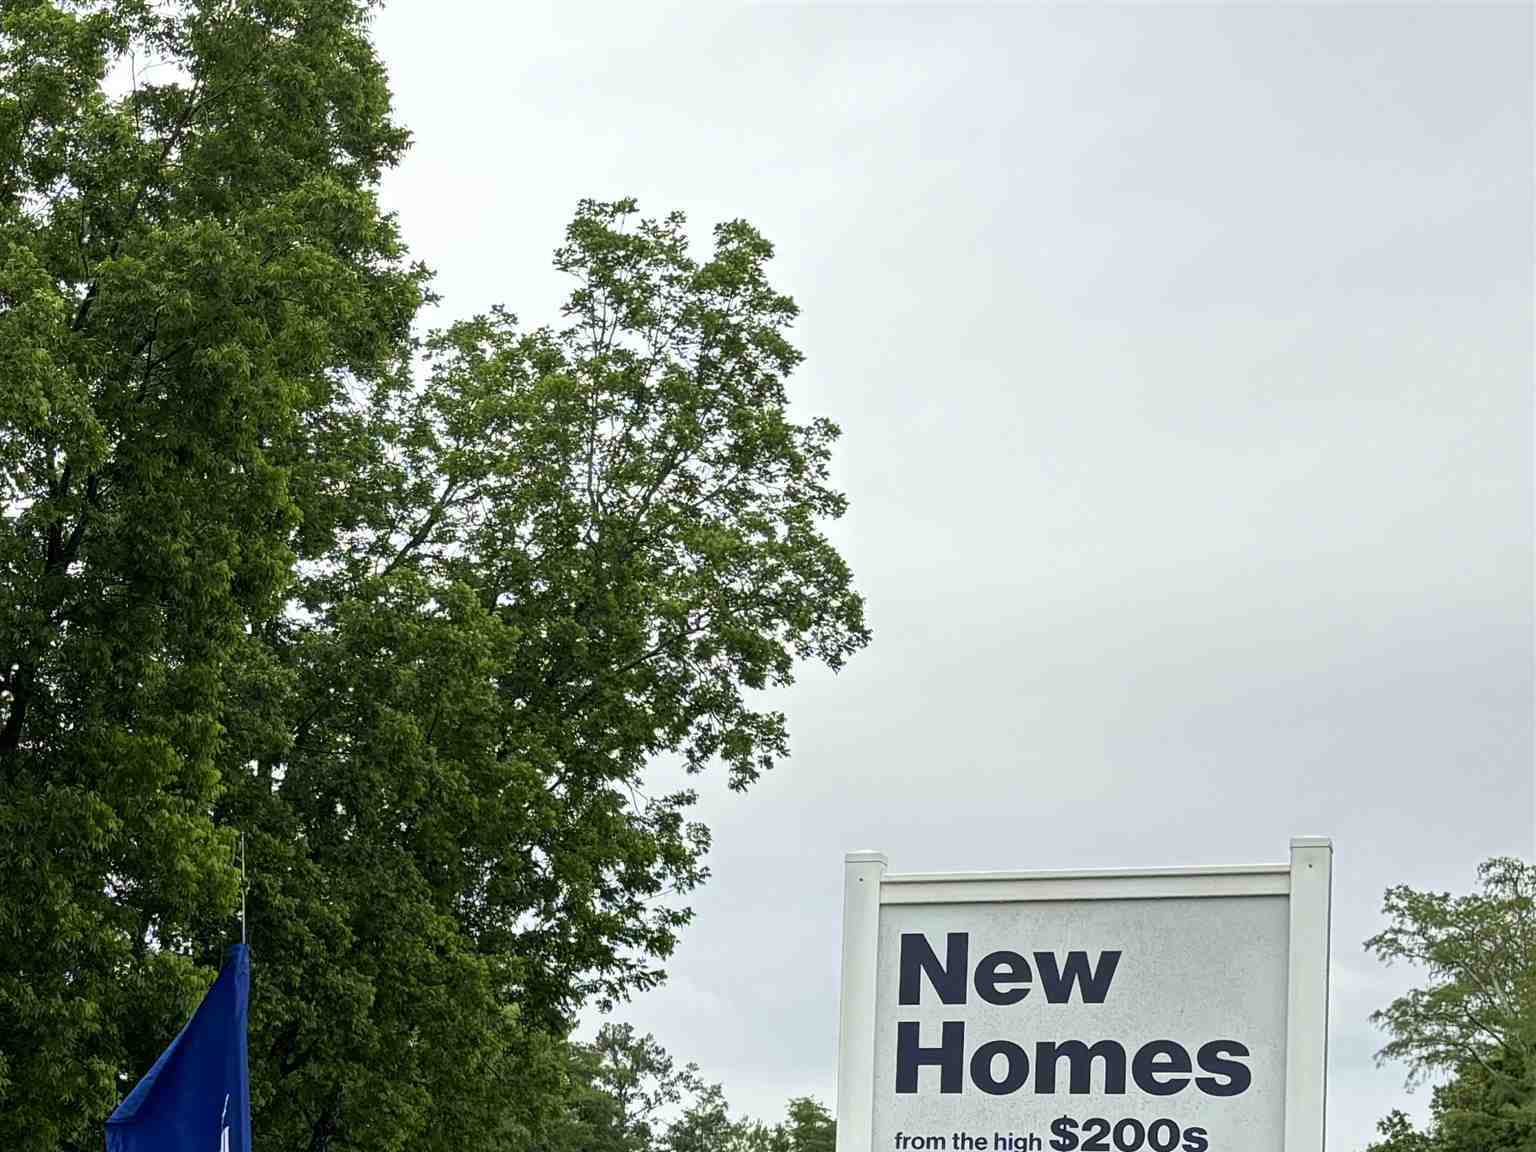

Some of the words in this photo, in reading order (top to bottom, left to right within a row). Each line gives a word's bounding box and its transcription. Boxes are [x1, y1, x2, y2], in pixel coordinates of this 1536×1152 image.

[898, 932, 1123, 1006] New
[895, 1020, 1252, 1097] Homes
[894, 1131, 946, 1151] from
[951, 1131, 988, 1151] the
